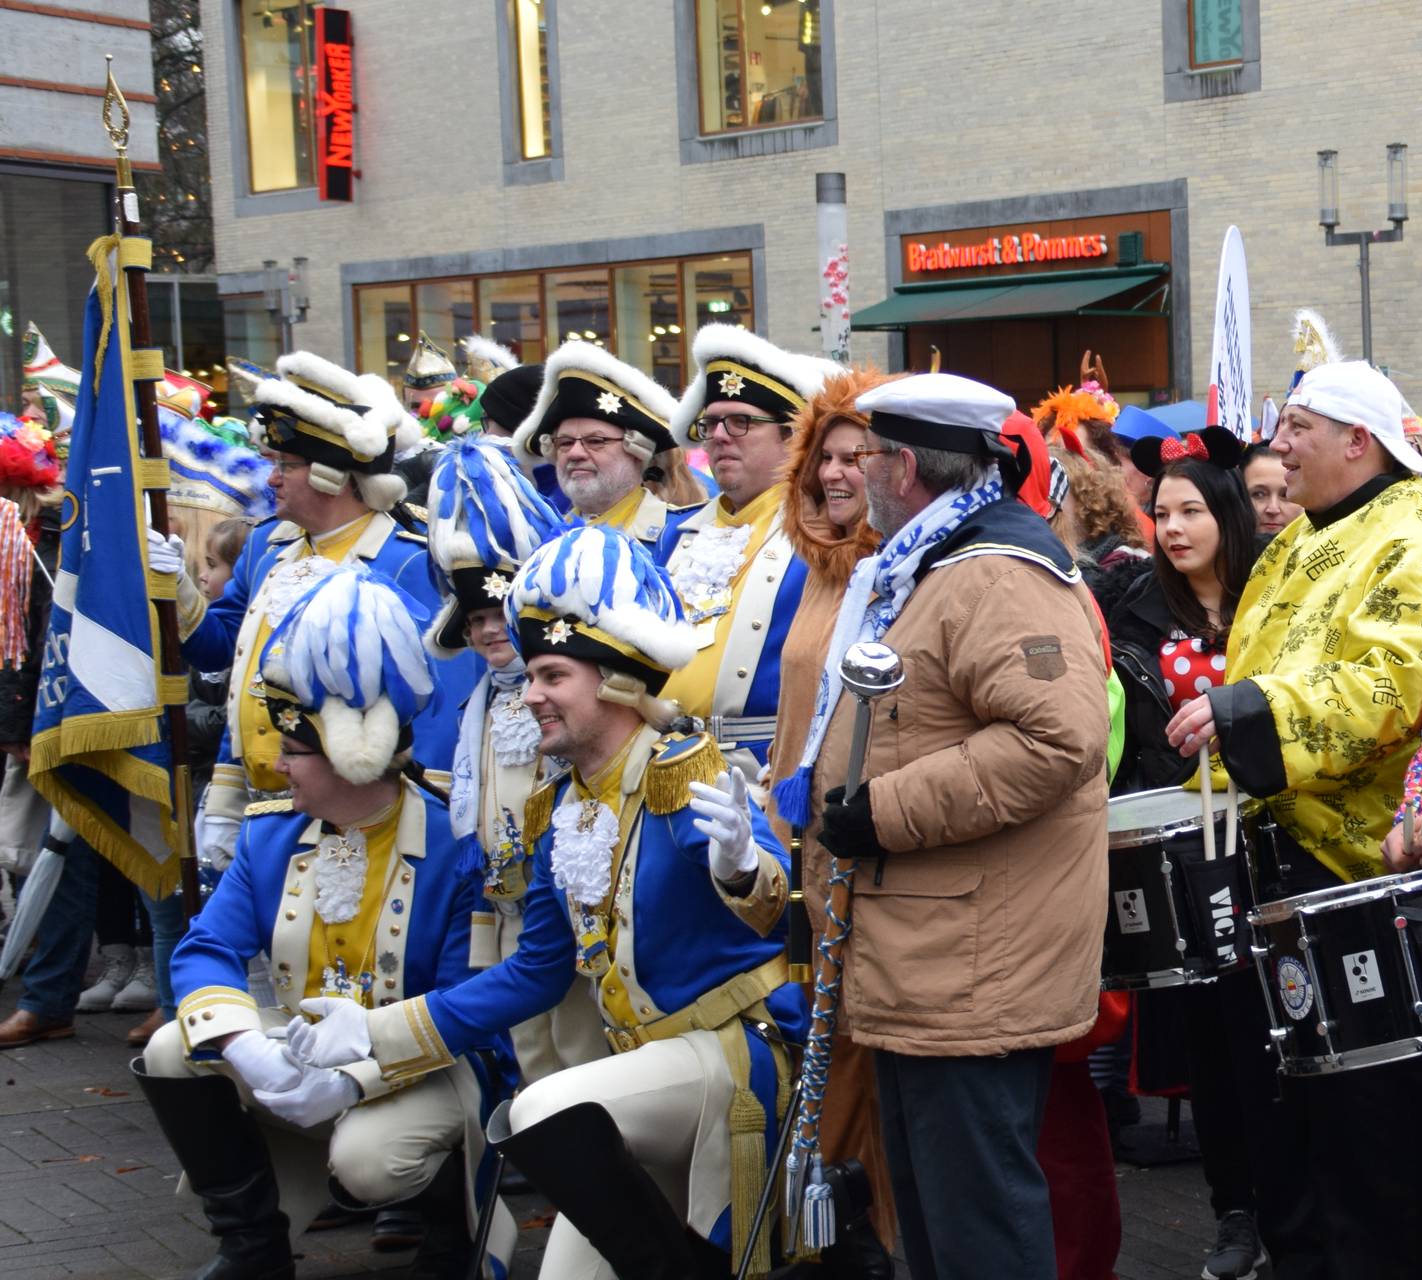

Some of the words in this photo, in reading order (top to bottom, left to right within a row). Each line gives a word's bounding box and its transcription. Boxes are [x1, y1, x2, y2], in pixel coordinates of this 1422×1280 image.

[908, 238, 1001, 272] Bratwurst
[1002, 234, 1023, 265] &
[1022, 232, 1108, 262] Pommes
[1209, 886, 1237, 937] VIC
